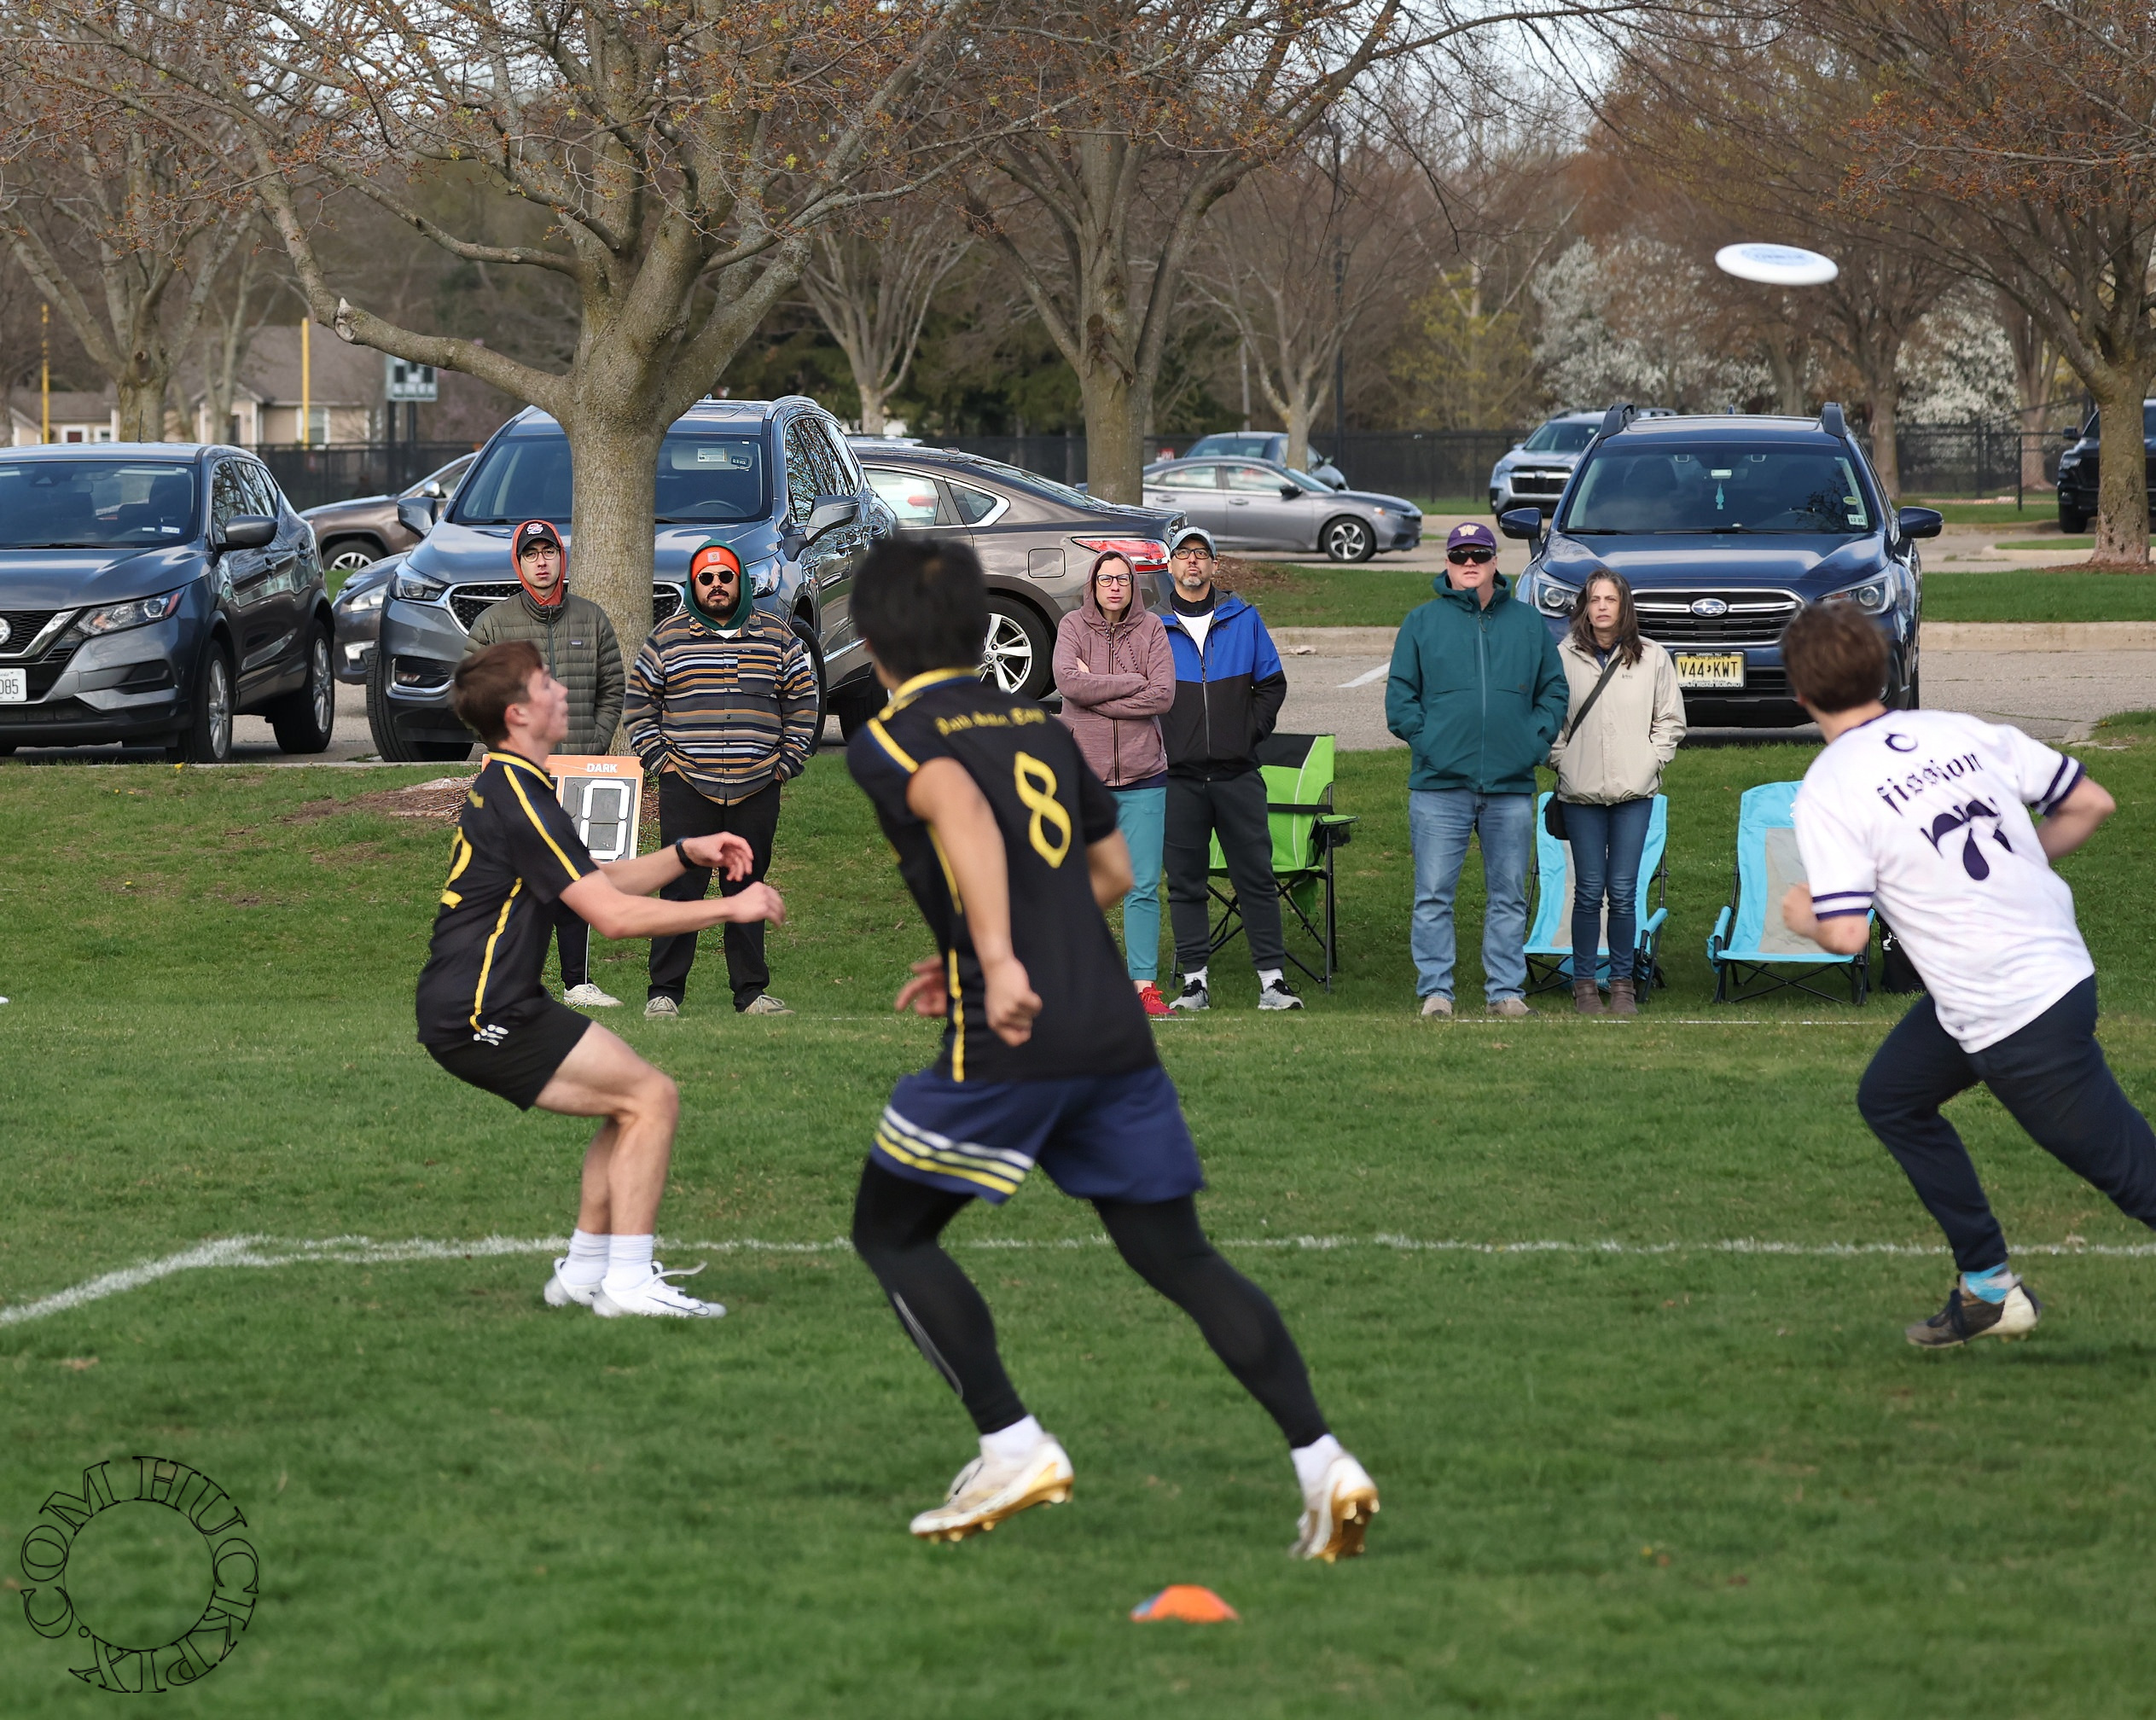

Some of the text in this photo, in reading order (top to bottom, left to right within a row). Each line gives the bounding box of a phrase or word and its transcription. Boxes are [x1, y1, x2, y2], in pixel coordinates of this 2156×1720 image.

[1458, 525, 1479, 537] W
[586, 763, 618, 773] DARK
[1877, 752, 1984, 816] fission
[579, 779, 631, 860] 0
[1014, 752, 1072, 869] 8
